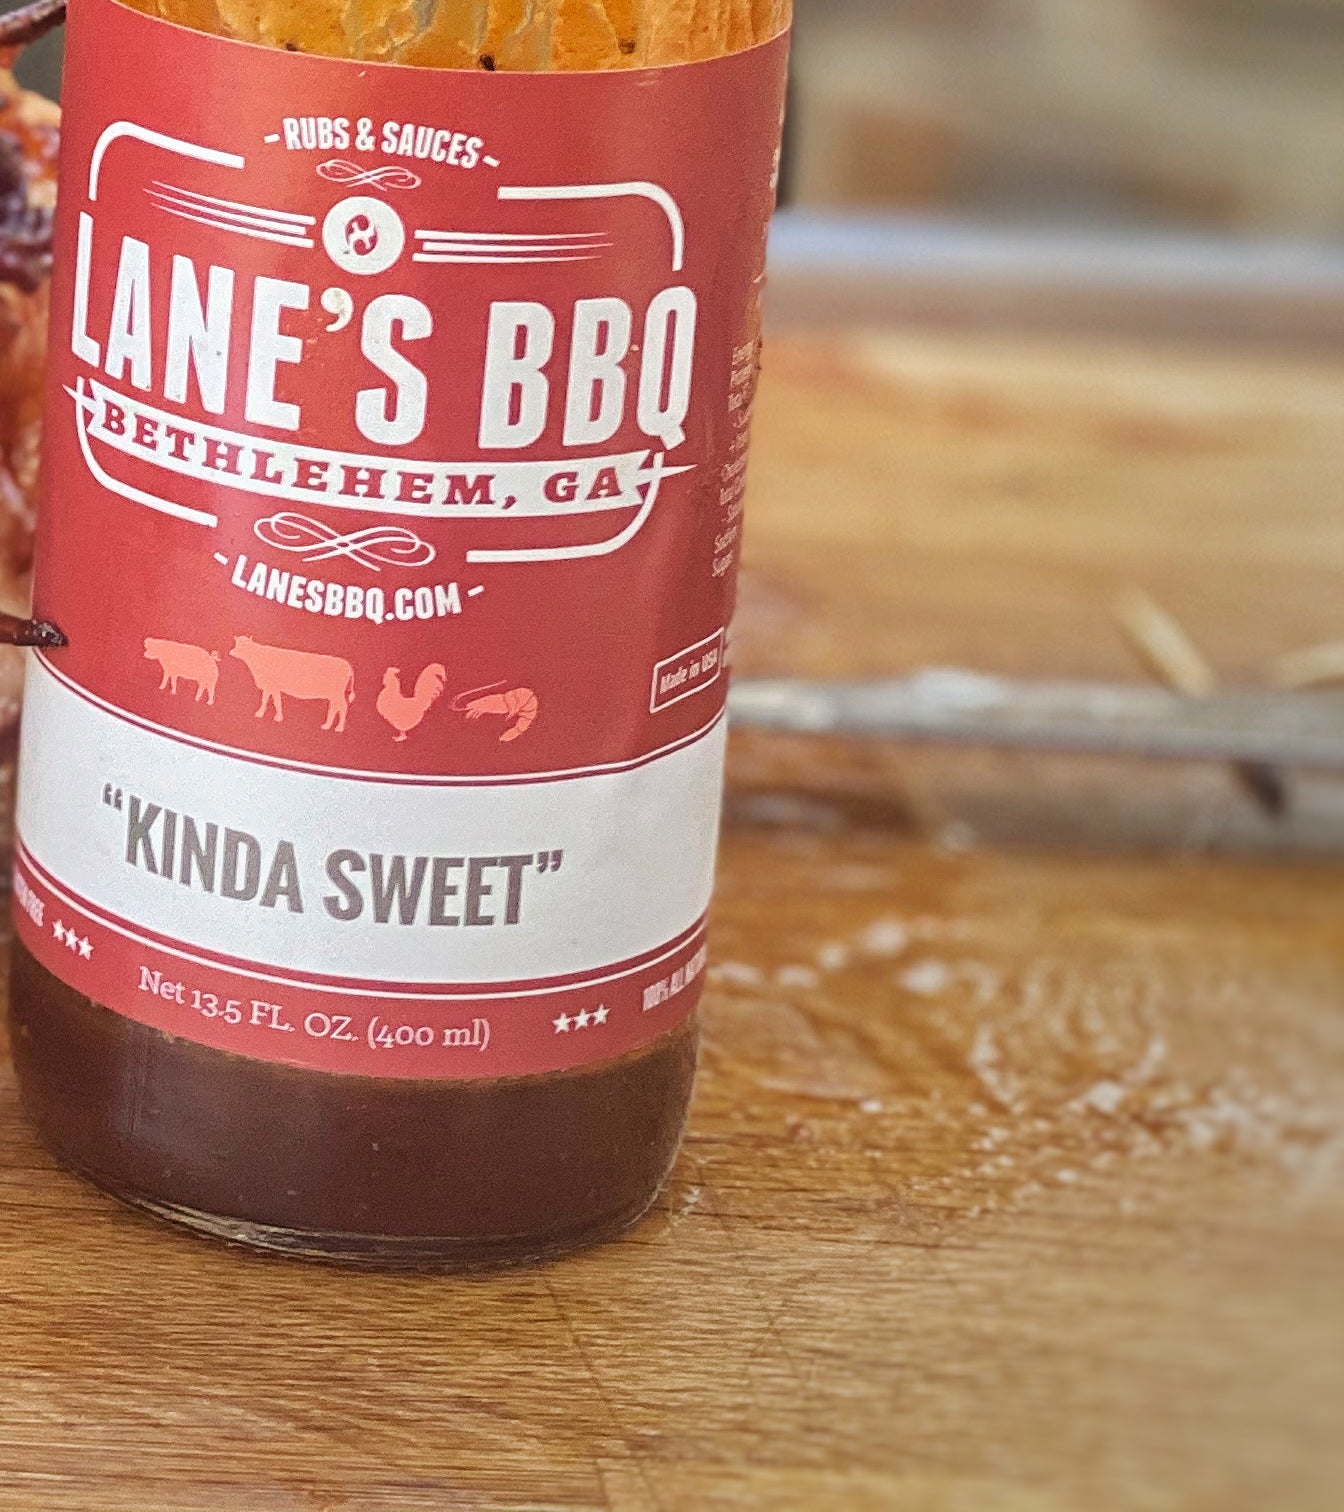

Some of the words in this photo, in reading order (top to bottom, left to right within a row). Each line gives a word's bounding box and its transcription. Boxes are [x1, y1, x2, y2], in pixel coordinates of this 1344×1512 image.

[355, 117, 376, 152] &
[70, 211, 433, 447] LANE'S
[477, 285, 698, 451] BBQ
[100, 398, 517, 511] BETHLEHEM,
[542, 470, 625, 501] GA
[138, 966, 186, 1005] Net
[191, 988, 242, 1025] 13.5
[248, 999, 296, 1033] FL.
[303, 1012, 360, 1042] OZ.
[367, 1015, 435, 1051] (400
[442, 1017, 491, 1052] ml)
